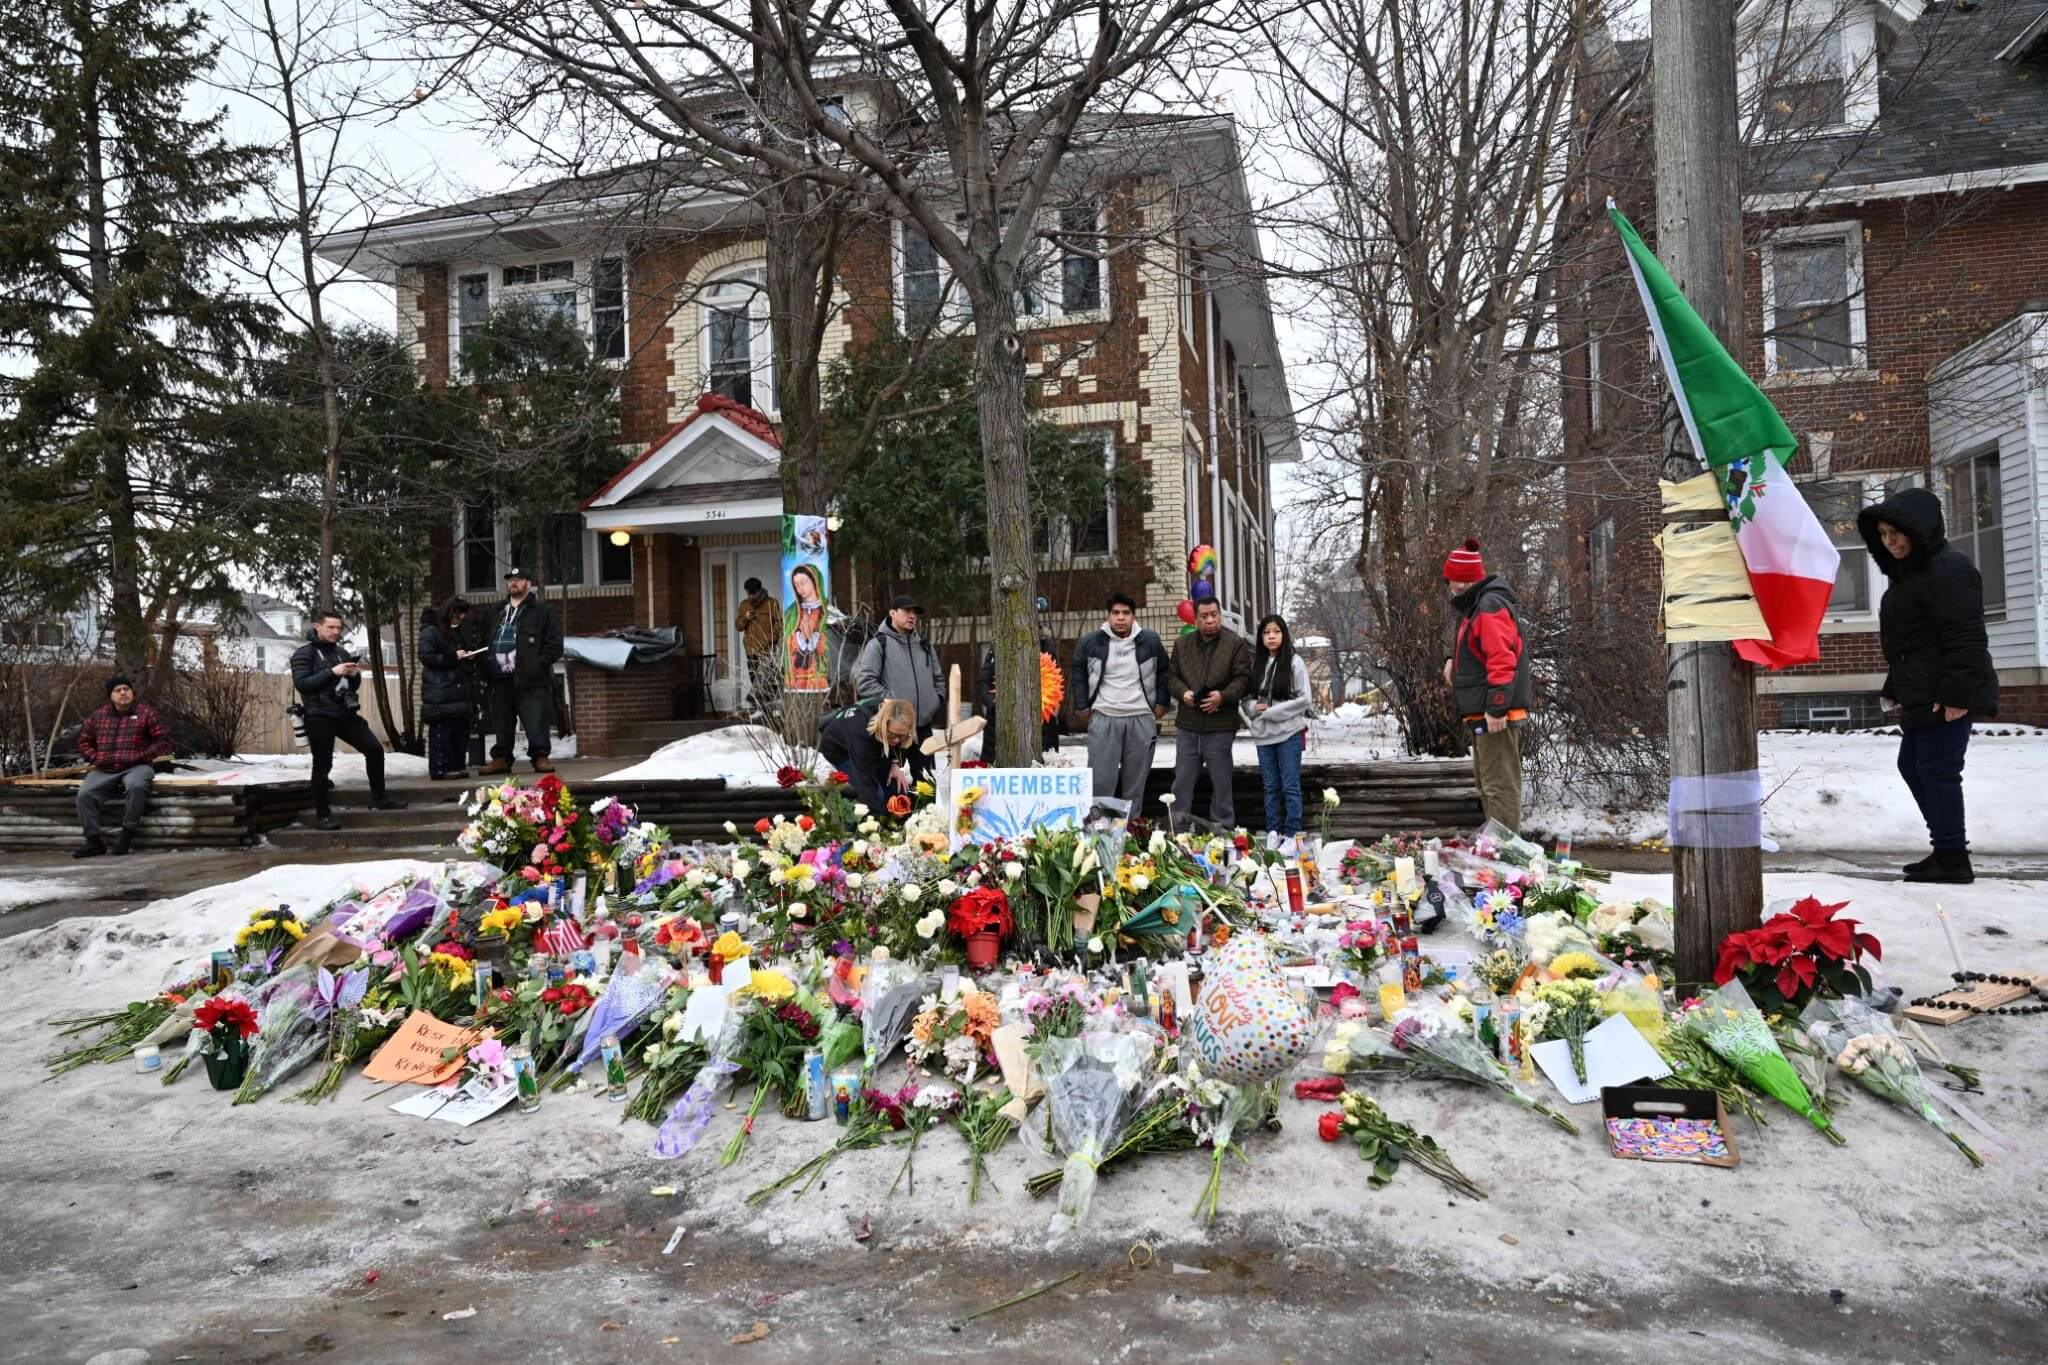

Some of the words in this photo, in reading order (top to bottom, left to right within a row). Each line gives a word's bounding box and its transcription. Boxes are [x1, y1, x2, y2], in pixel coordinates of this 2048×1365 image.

[962, 775, 1081, 795] REMEMBER
[1194, 1009, 1221, 1064] HUGS
[1206, 984, 1240, 1038] LOVE
